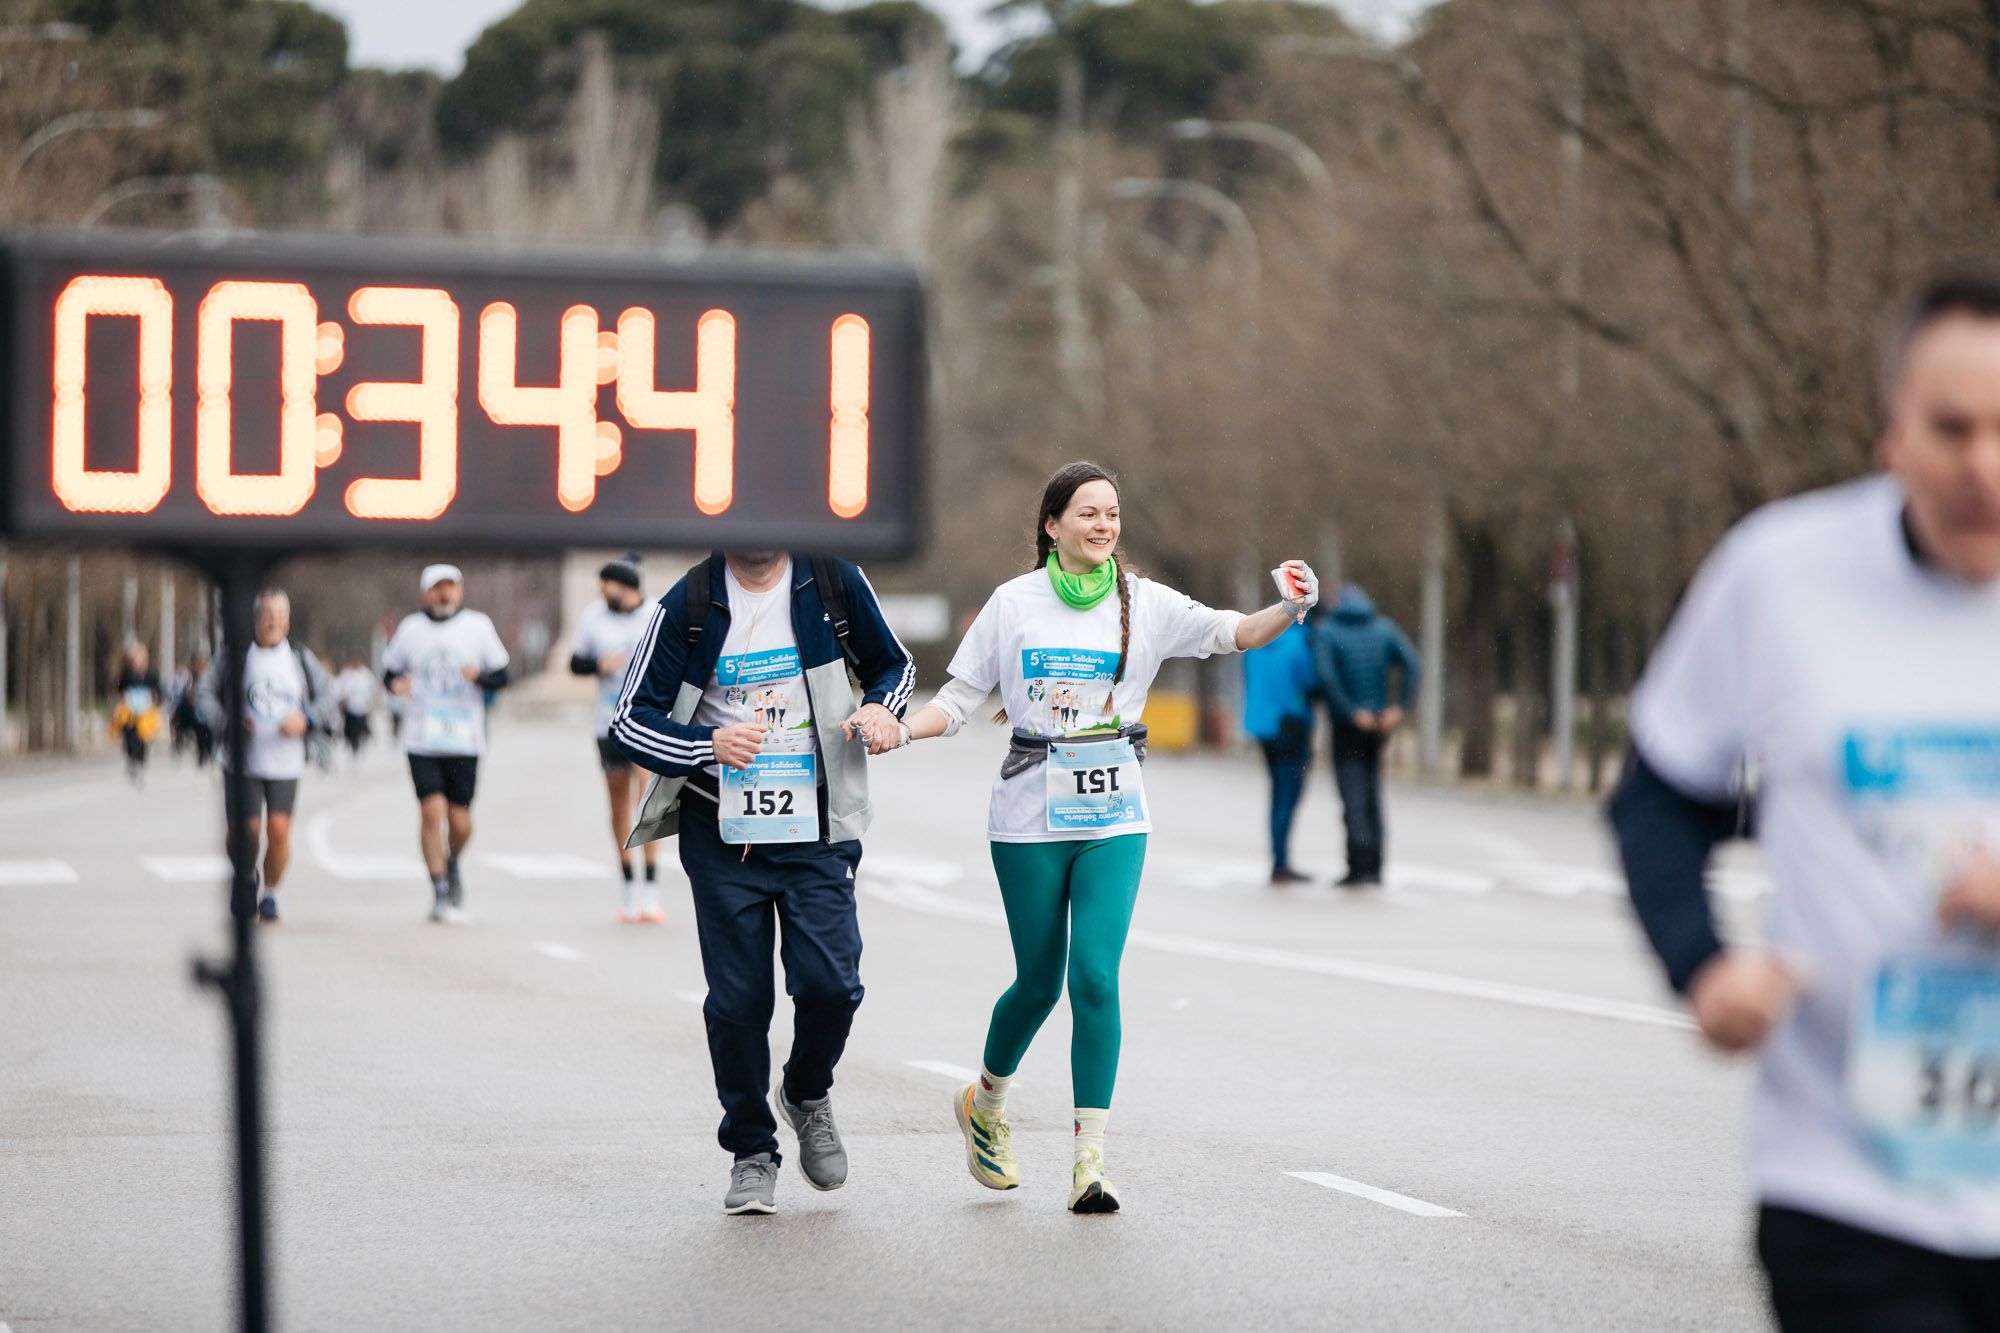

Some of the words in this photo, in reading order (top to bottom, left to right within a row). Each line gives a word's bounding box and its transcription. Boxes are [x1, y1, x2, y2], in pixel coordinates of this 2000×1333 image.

[769, 653, 800, 664] Solidari
[1041, 653, 1070, 662] Carrera
[1072, 654, 1105, 665] Solidaria
[770, 761, 802, 769] Solidaria
[1073, 767, 1119, 794] 151
[743, 790, 794, 815] 152
[1064, 814, 1097, 822] Solidaria
[1099, 811, 1124, 819] Carrera
